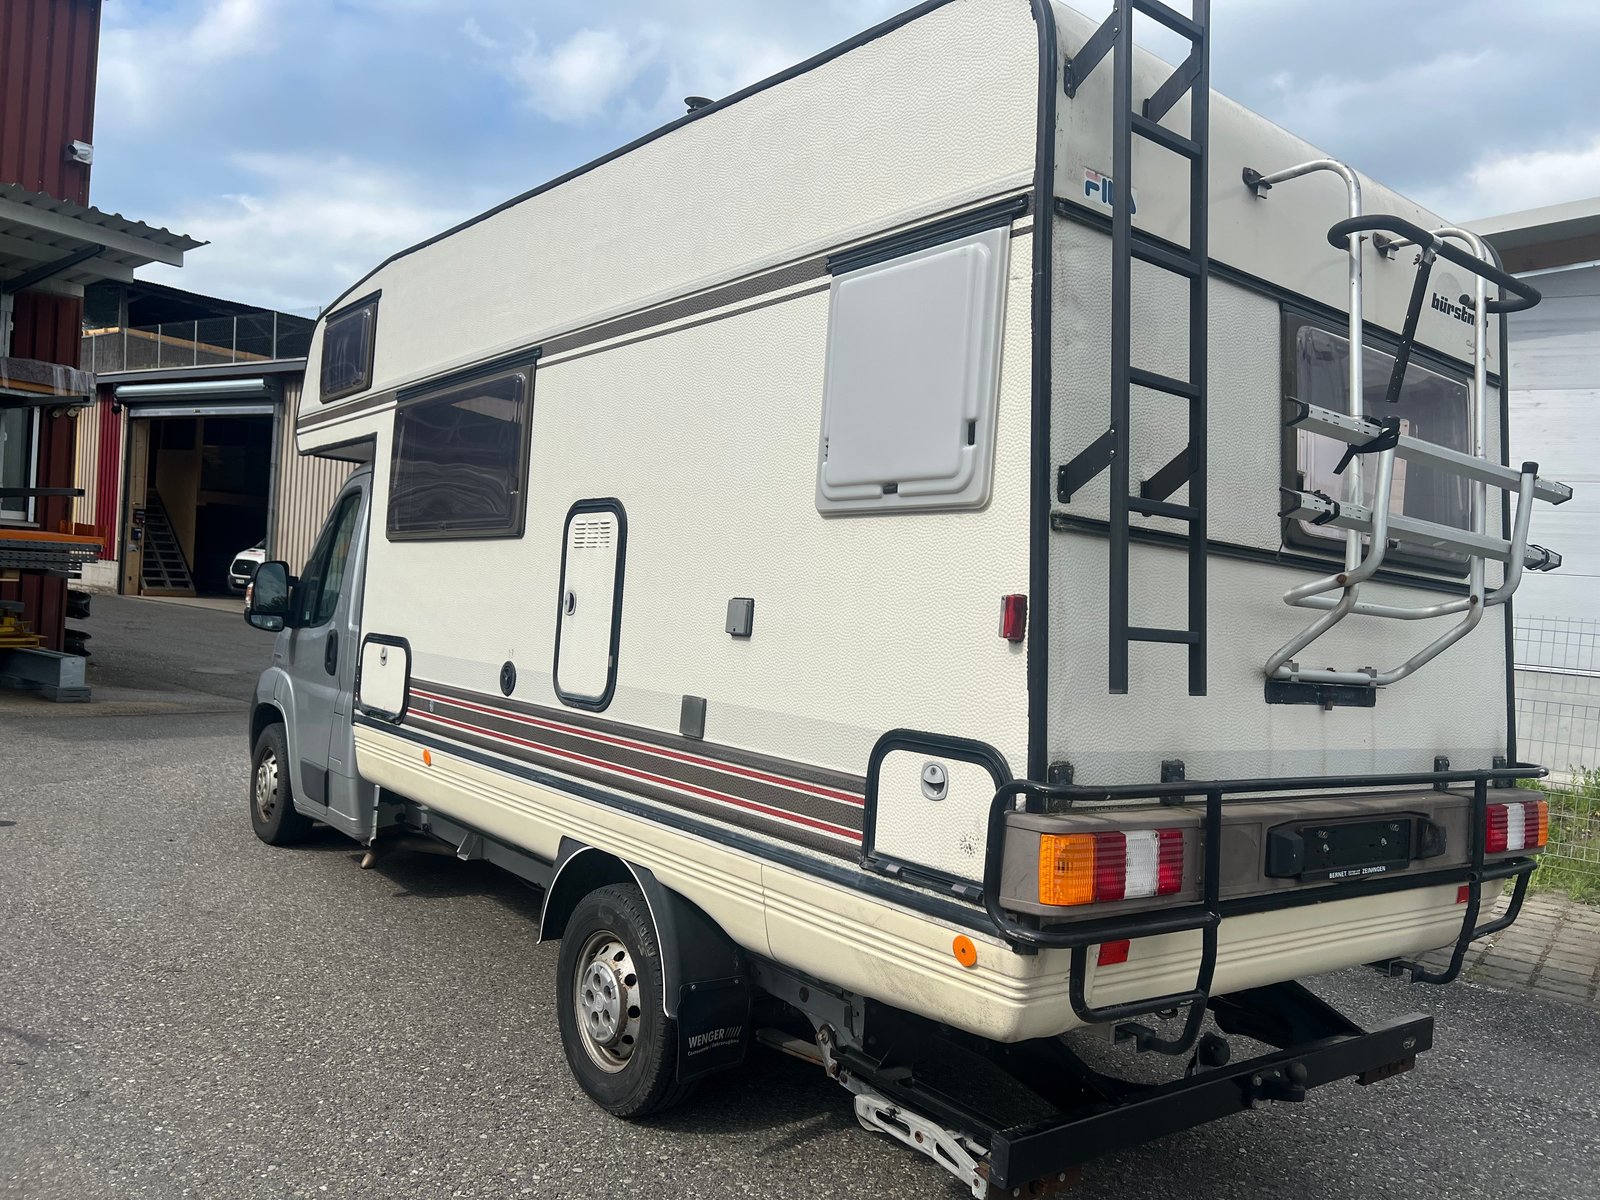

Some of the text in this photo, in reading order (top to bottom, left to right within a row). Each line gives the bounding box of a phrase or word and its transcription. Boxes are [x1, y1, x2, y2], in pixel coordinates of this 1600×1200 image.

[1085, 170, 1136, 214] FIL
[1431, 292, 1489, 328] bürstn
[1329, 871, 1347, 879] BERNET
[1362, 865, 1386, 875] ZEININGEN
[688, 1028, 725, 1049] WENGER
